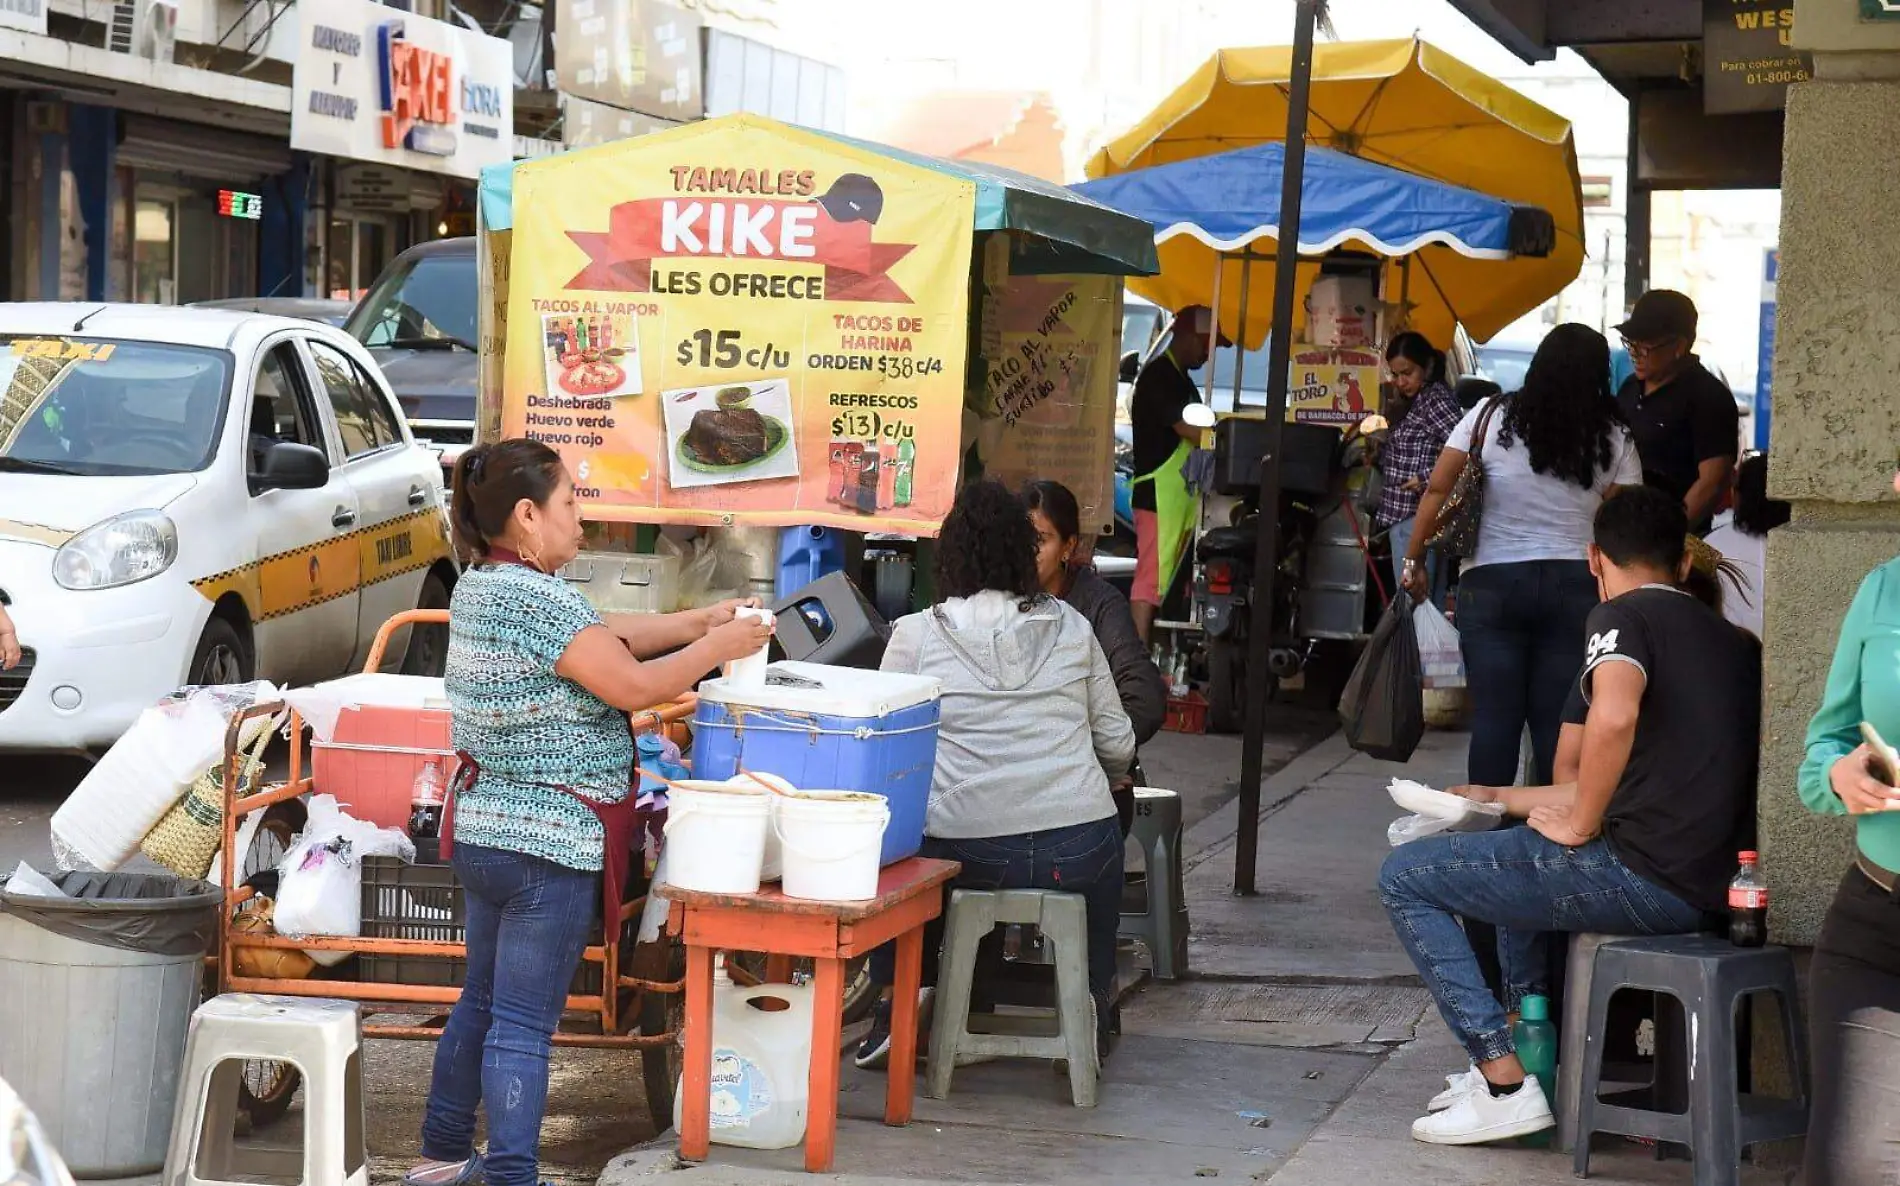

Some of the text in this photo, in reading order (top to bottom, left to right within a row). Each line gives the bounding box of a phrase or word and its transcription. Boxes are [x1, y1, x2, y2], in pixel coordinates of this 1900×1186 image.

[1721, 61, 1746, 71] Para
[1748, 59, 1784, 69] cobrar
[391, 41, 457, 125] AXEL
[670, 165, 817, 196] TAMALES
[661, 200, 818, 257] KIKE
[652, 270, 823, 299] LES OFRECE
[532, 298, 659, 316] TACOS AL VAPOR
[1037, 291, 1077, 337] VAPOR
[833, 314, 923, 332] TACOS DE
[11, 340, 116, 361] TAXI
[677, 329, 790, 370] $15 c/u
[841, 335, 912, 352] HARINA
[808, 354, 943, 379] ORDEN $38 c/4
[1304, 372, 1317, 385] EL
[829, 393, 918, 409] REFRESCOS
[1291, 385, 1328, 401] TORO
[527, 394, 612, 411] Deshebrada
[526, 413, 615, 428] Huevo verde
[883, 420, 914, 439] c/u
[525, 430, 603, 448] Huevo rojo
[1586, 629, 1619, 665] 94
